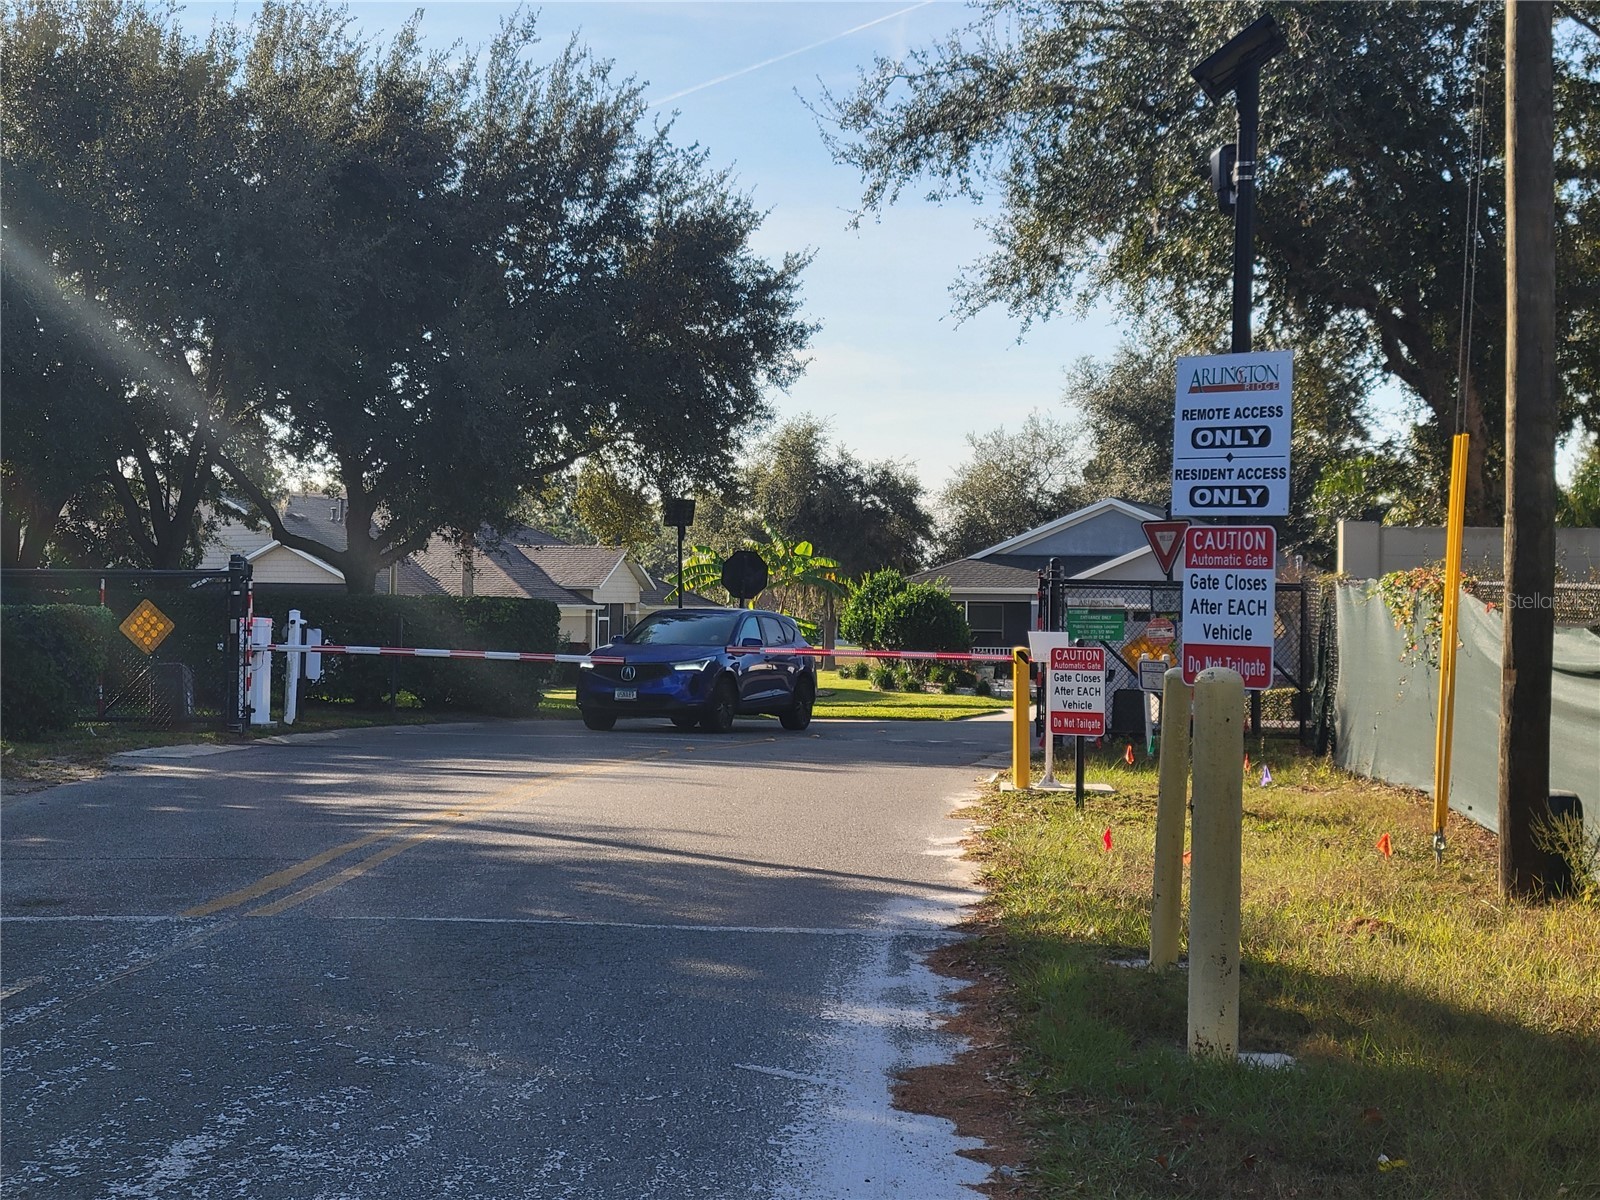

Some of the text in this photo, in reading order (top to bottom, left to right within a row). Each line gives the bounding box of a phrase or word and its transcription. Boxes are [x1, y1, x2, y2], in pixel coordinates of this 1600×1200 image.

[1188, 364, 1279, 394] ARLINGTON
[1244, 383, 1278, 391] RIDGE
[1182, 405, 1283, 421] REMOTE ACCESS
[1196, 428, 1266, 447] ONLY
[1175, 467, 1287, 481] RESIDENT ACCESS
[1194, 488, 1264, 505] ONLY
[1193, 531, 1266, 550] CAUTION
[1191, 554, 1268, 566] Automatic Gate
[1190, 573, 1267, 591] Gate Closes
[1190, 598, 1267, 616] After EACH
[1203, 623, 1252, 641] Vehicle
[1055, 650, 1100, 660] CAUTION
[1054, 662, 1101, 670] Automatic Gate
[1188, 656, 1201, 673] Do
[1053, 673, 1101, 683] Gate Closes
[1054, 686, 1101, 697] After EACH
[1062, 700, 1093, 710] Vehicle
[1053, 718, 1101, 731] Do Not Tailgate
